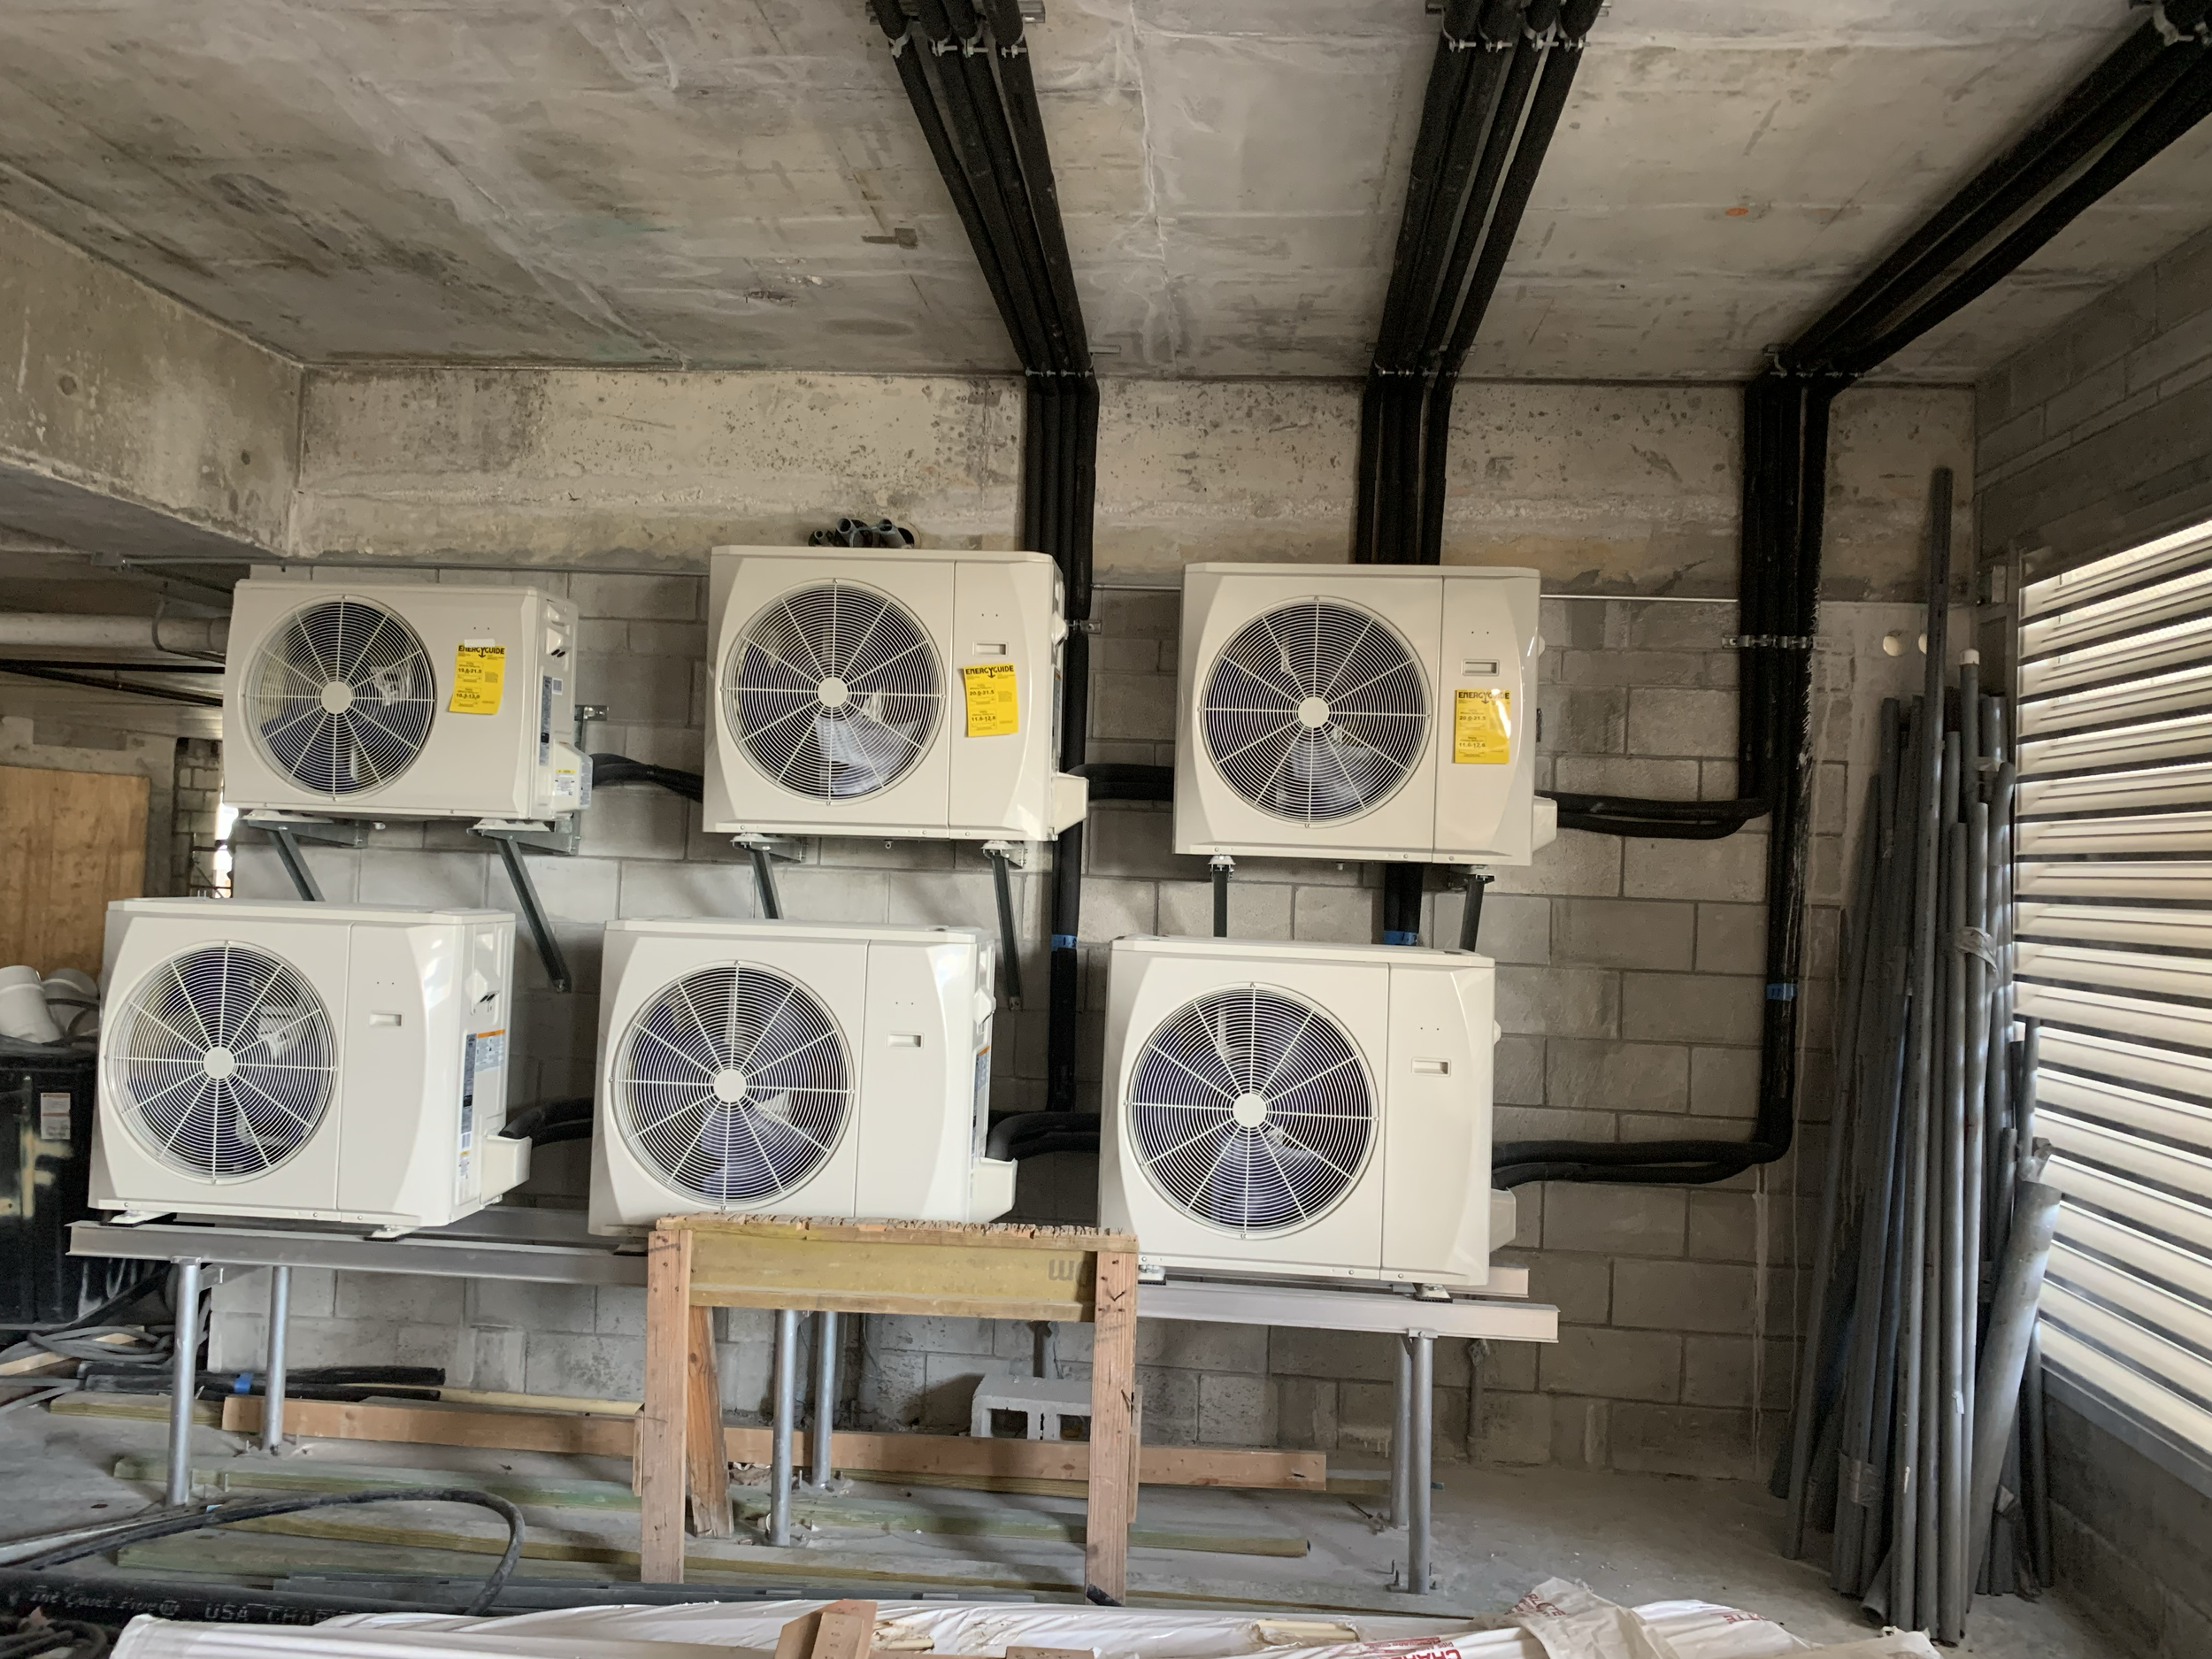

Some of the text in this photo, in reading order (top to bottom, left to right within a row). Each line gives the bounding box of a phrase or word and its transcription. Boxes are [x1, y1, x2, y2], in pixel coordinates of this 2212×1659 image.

[457, 645, 505, 656] ENERGYGUIDE
[965, 664, 1014, 676] ENERGYGUIDE
[204, 1601, 250, 1623] USA
